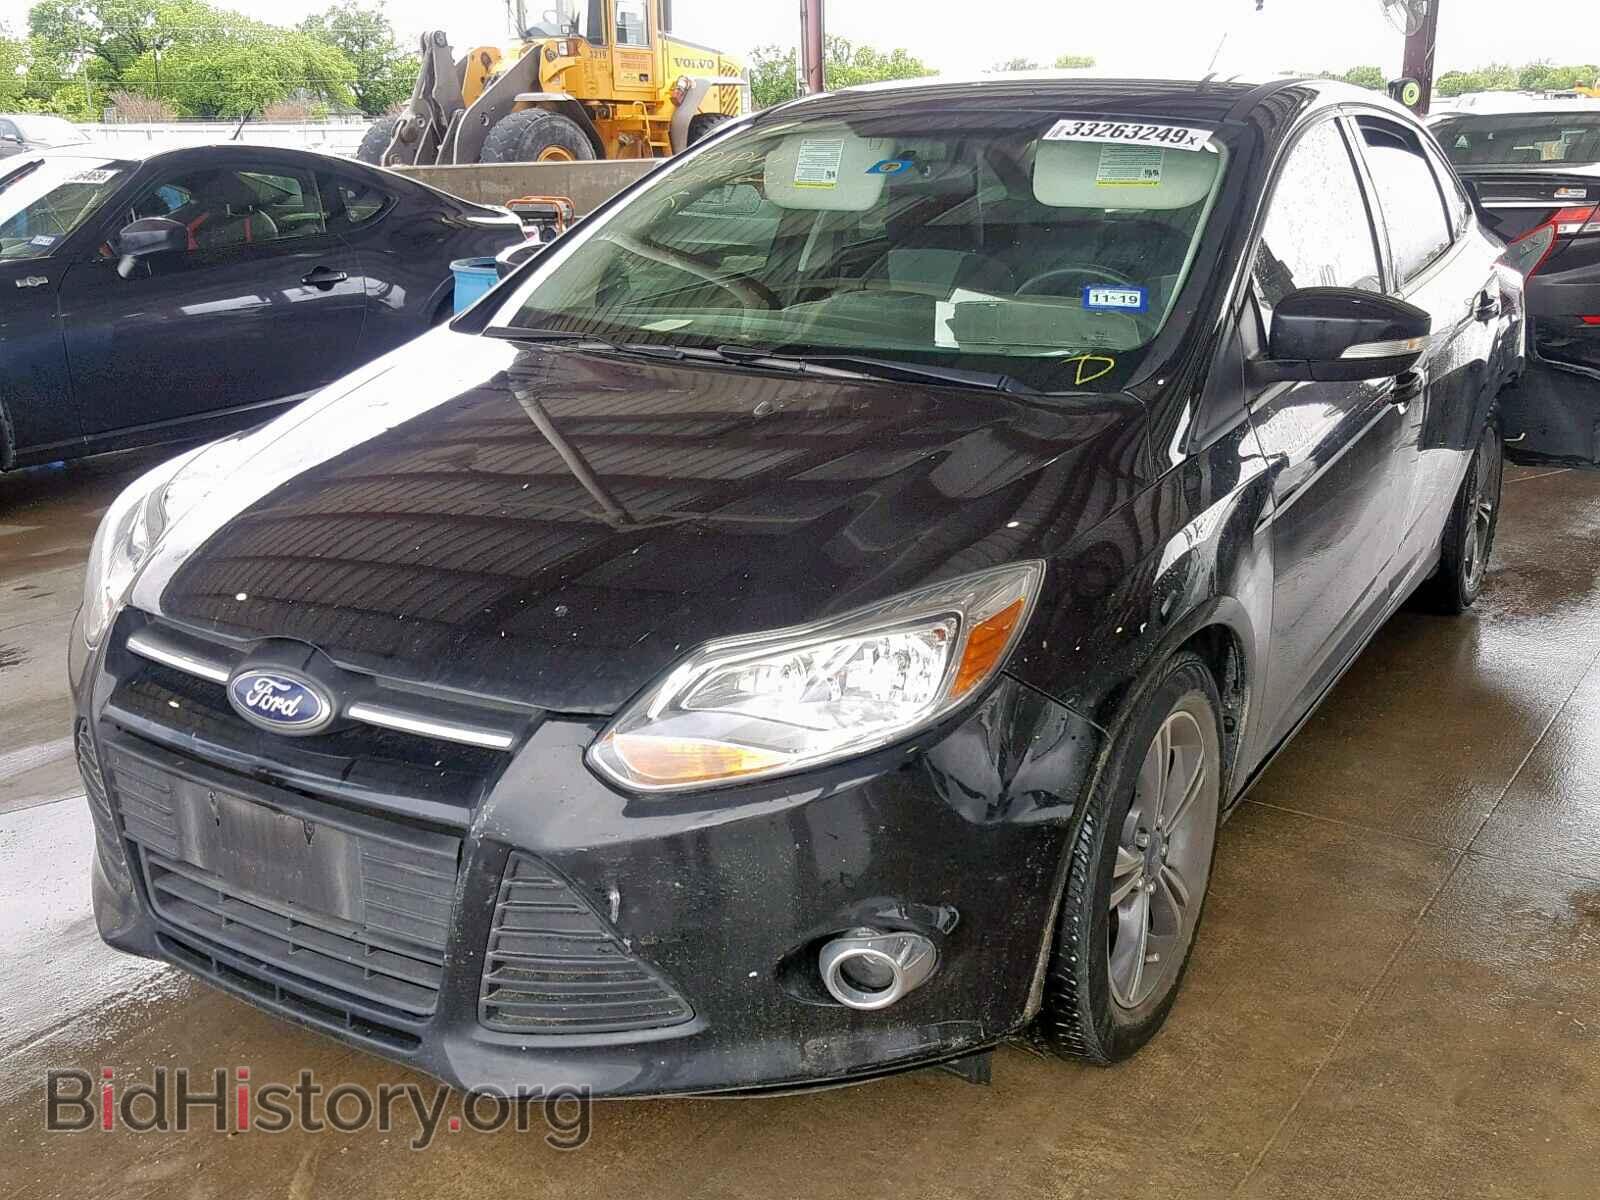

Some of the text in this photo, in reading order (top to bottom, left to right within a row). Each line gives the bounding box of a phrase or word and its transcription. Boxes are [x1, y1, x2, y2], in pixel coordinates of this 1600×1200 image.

[674, 57, 715, 69] VOLVO
[1058, 354, 1115, 385] D
[246, 678, 303, 717] Ford
